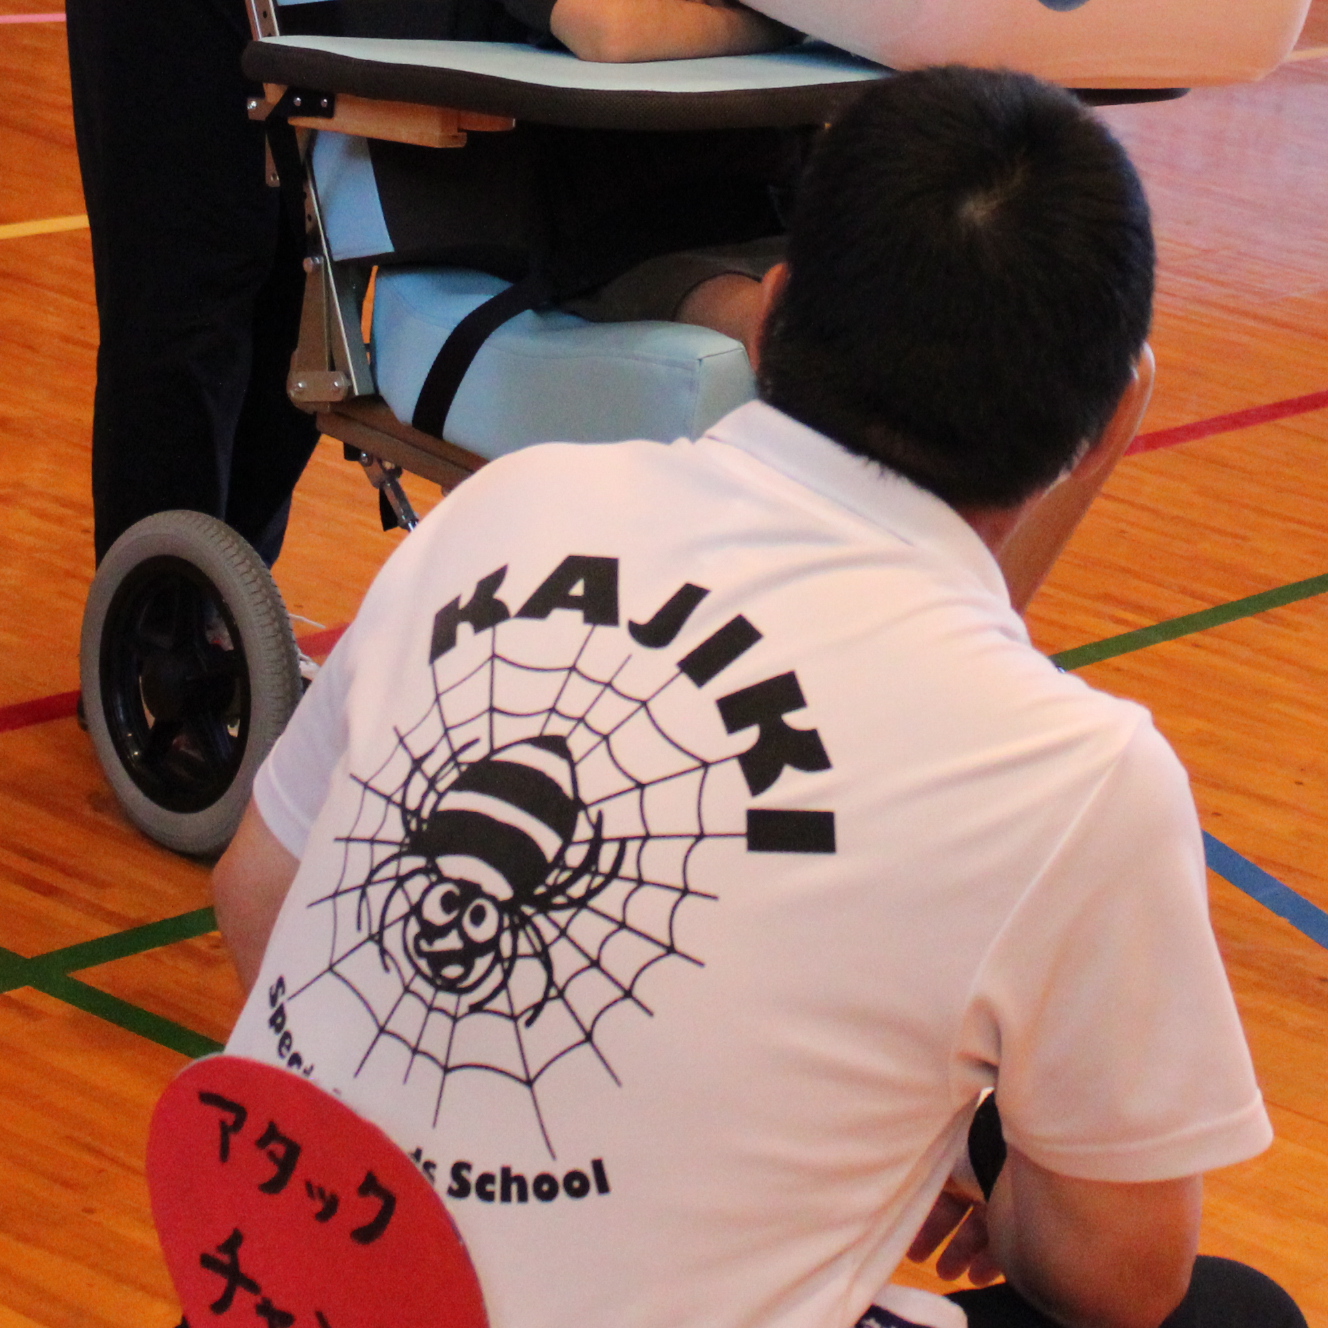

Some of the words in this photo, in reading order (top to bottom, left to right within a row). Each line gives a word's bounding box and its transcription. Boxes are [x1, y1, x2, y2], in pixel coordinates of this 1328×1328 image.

[429, 555, 836, 854] KAJIKI
[198, 1091, 397, 1246] アタック
[268, 974, 342, 1096] Spec
[446, 1157, 611, 1204] School
[200, 1228, 333, 1328] チャ
